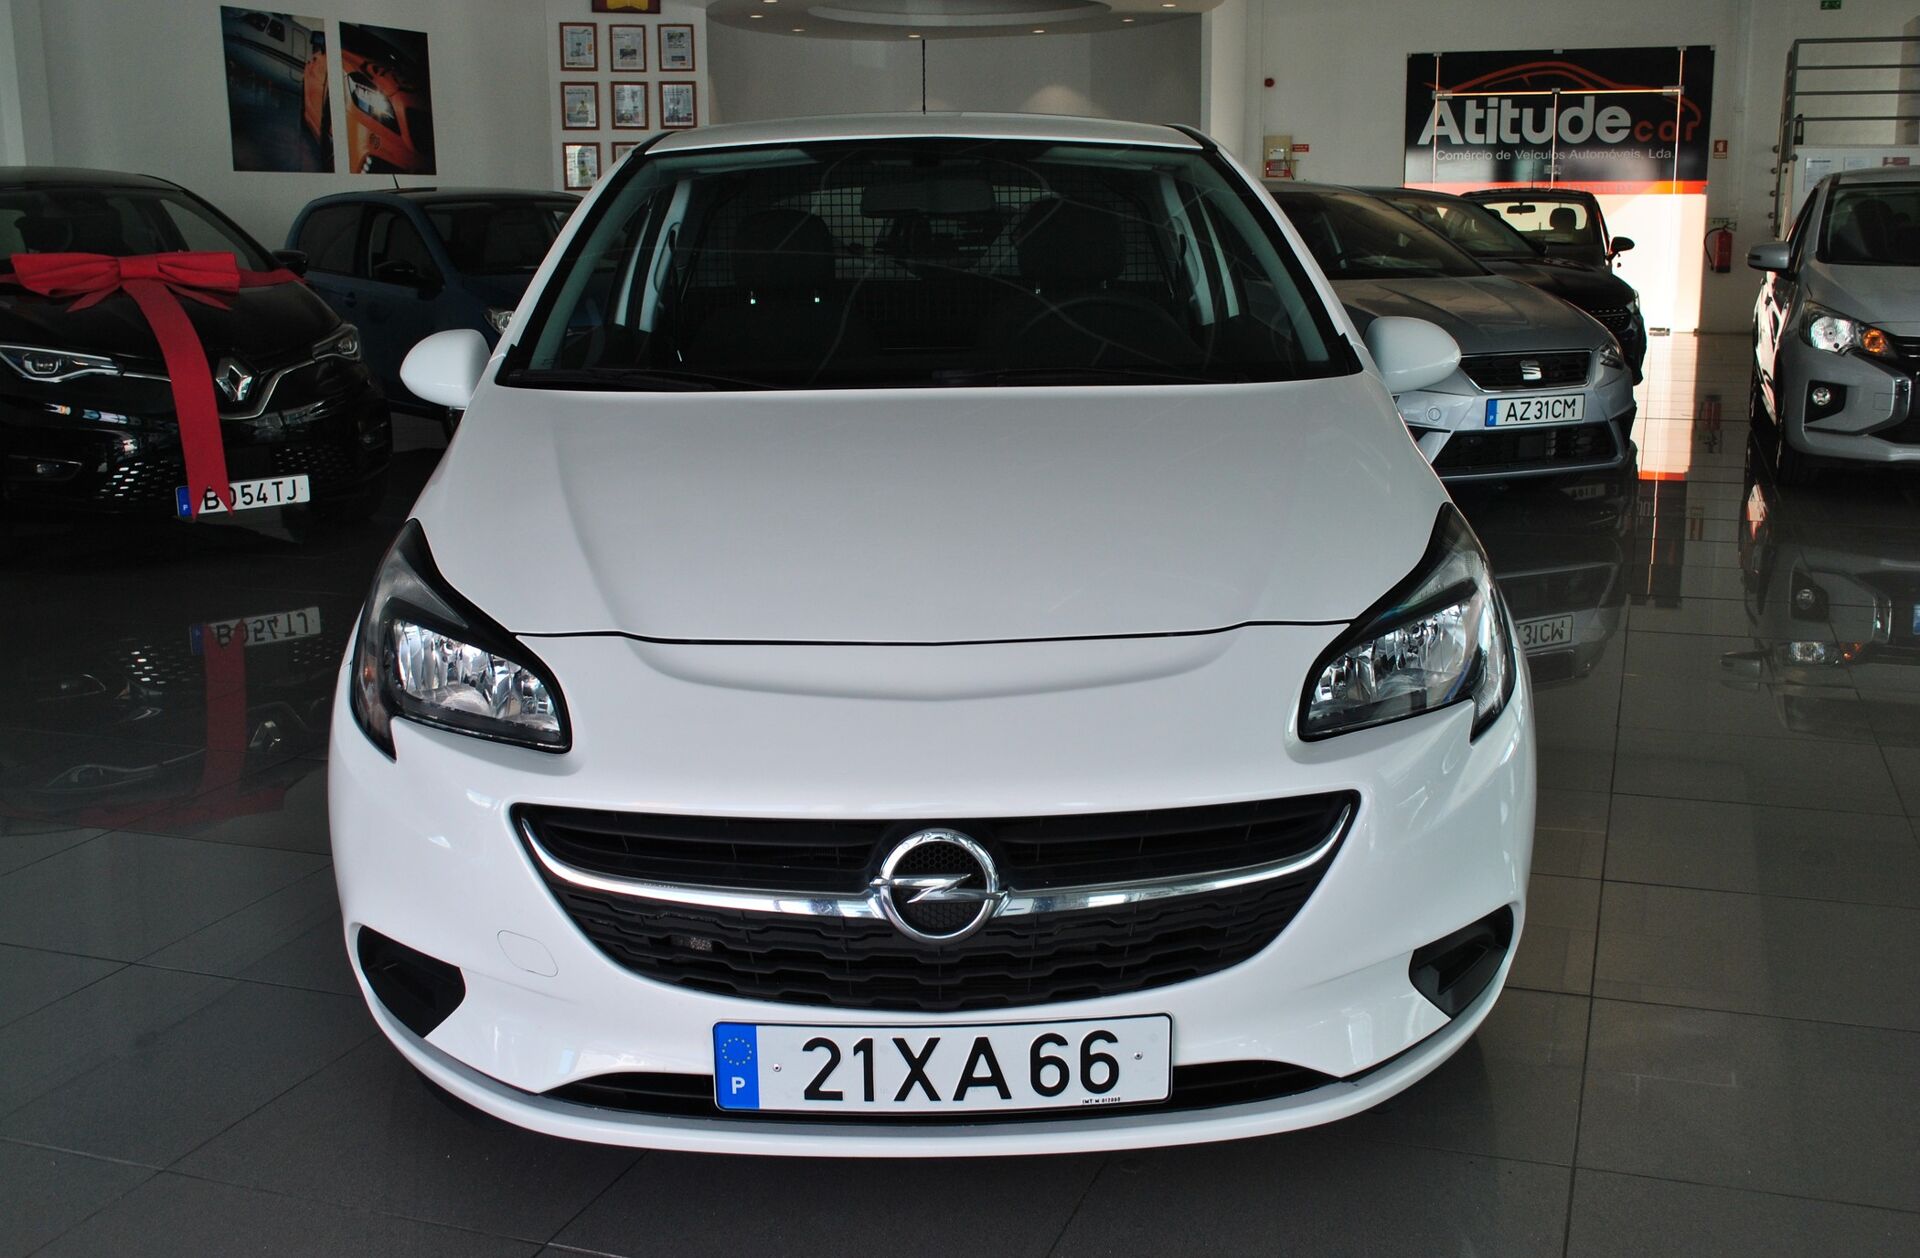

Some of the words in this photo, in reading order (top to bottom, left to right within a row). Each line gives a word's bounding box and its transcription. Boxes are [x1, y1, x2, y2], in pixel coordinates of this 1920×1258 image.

[1417, 96, 1631, 145] Atitude
[1436, 150, 1493, 160] Comércio
[1496, 150, 1511, 160] de
[1648, 149, 1675, 160] Lda.
[1505, 398, 1576, 422] AZ31CM
[731, 1076, 746, 1095] P
